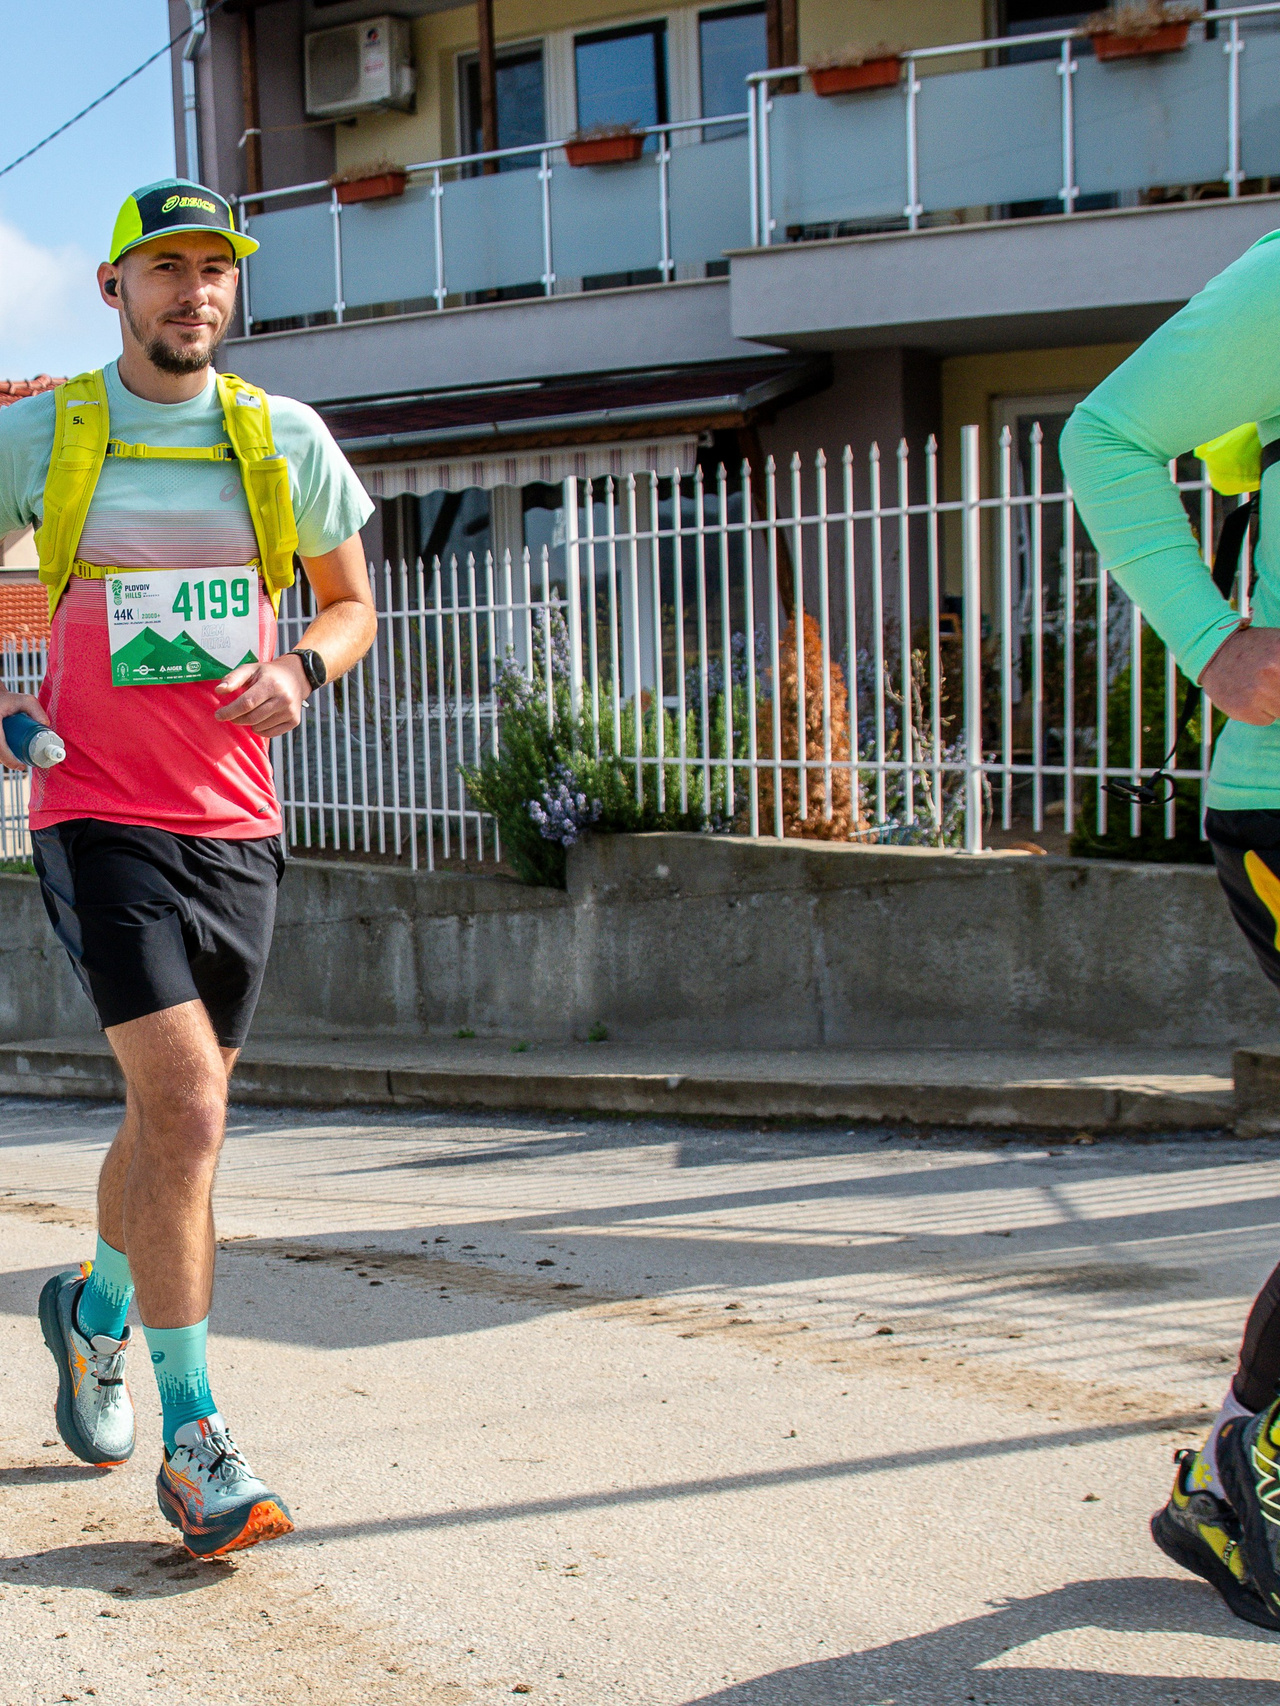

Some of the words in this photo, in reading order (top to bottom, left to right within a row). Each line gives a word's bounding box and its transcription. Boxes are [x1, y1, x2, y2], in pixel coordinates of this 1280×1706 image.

[179, 197, 216, 213] asics
[172, 578, 249, 621] 4199
[114, 609, 133, 620] 44K
